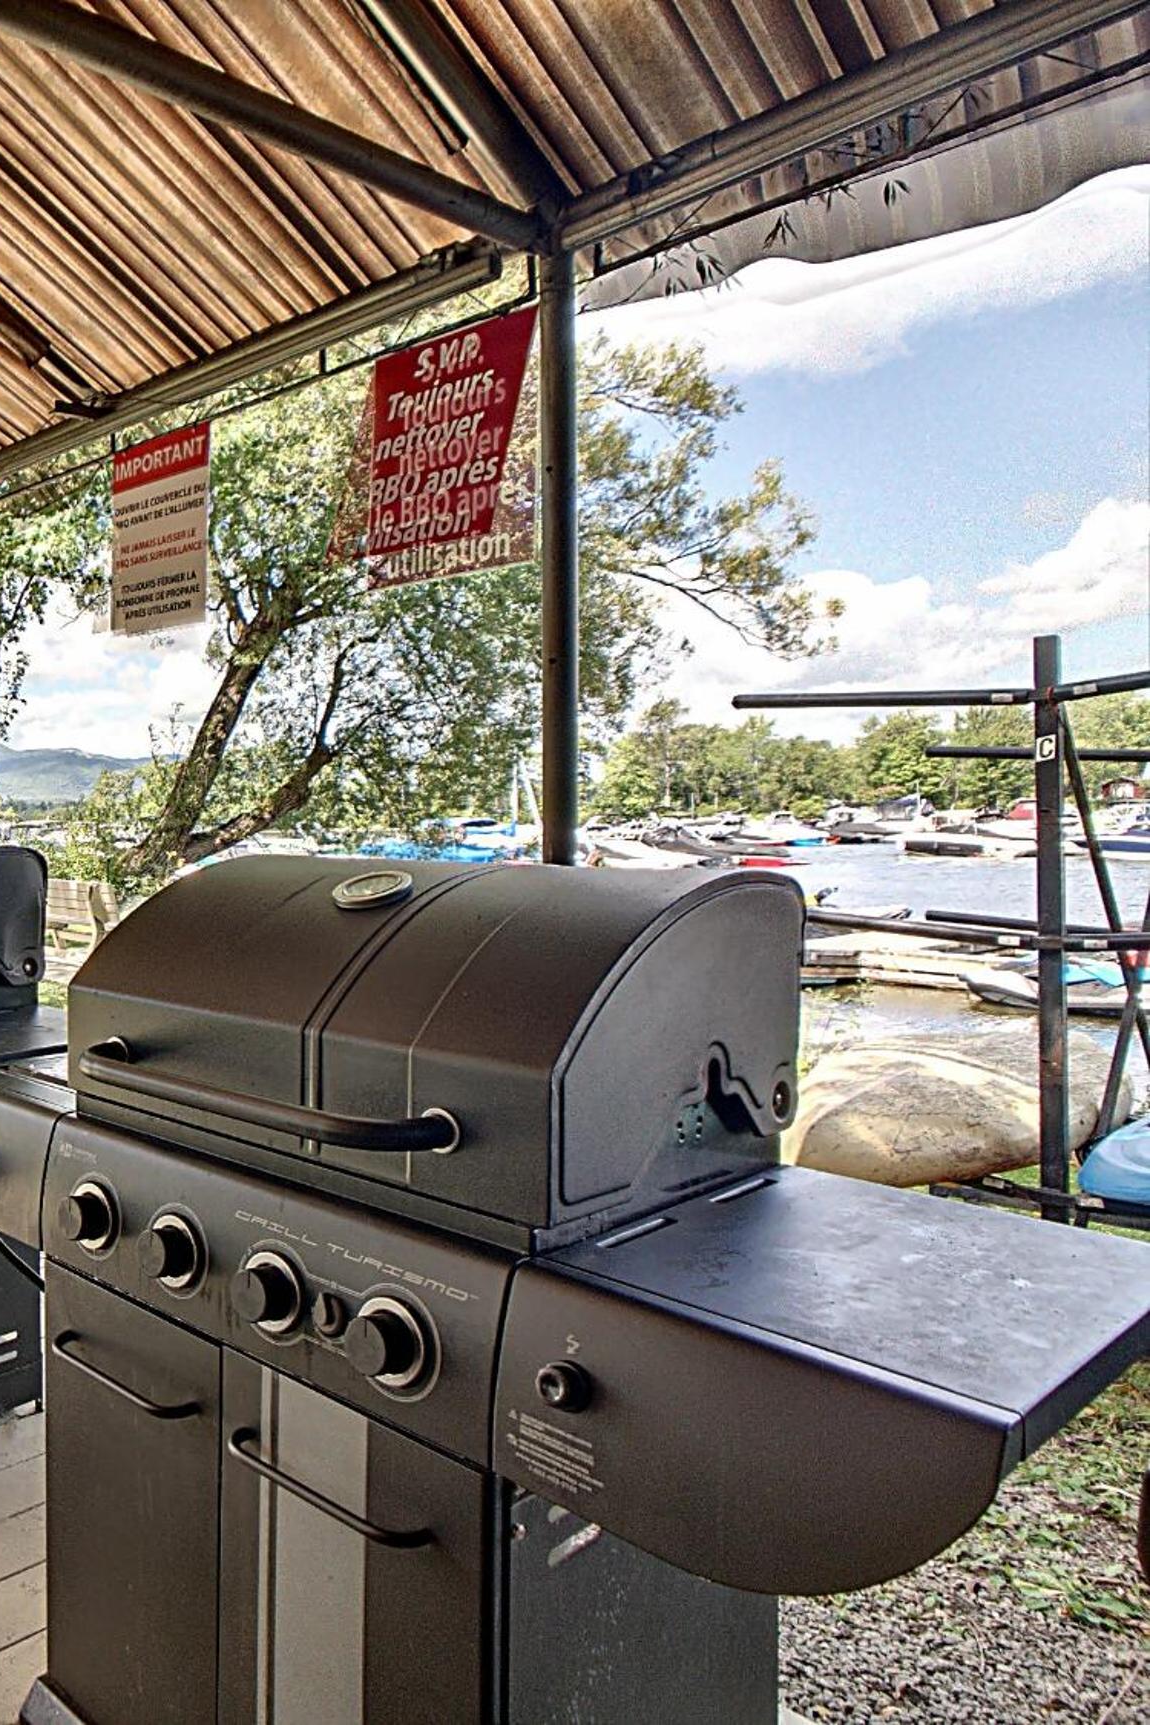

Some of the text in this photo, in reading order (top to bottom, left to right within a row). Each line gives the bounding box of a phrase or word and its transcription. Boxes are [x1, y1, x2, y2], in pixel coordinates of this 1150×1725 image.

[115, 434, 206, 482] IMPORTANT
[157, 530, 186, 545] LAISSER
[1039, 737, 1054, 759] C
